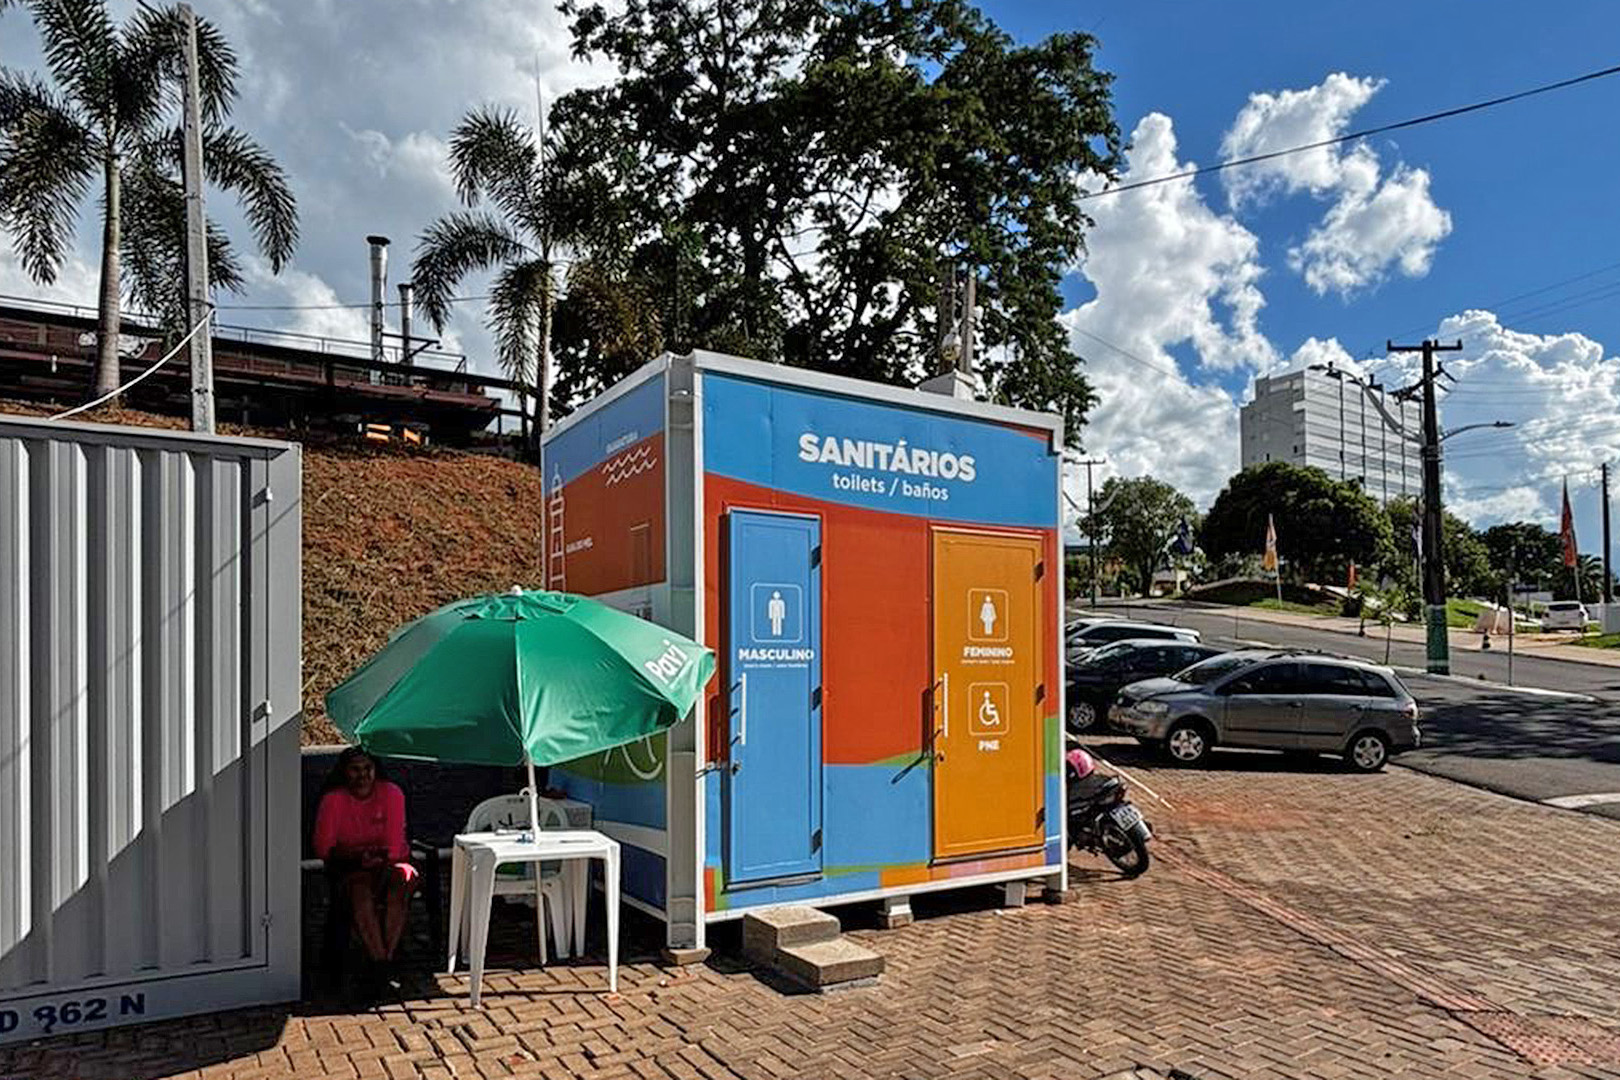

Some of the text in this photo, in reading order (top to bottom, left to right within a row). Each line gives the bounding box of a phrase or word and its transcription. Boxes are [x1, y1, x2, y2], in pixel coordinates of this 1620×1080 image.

[798, 432, 977, 482] SANITÁRIOS
[833, 473, 886, 493] toilets
[902, 479, 949, 501] baños
[644, 639, 688, 685] Pavi
[738, 647, 814, 661] MASCULINO
[963, 646, 1014, 658] FEMININO
[120, 993, 145, 1015] N
